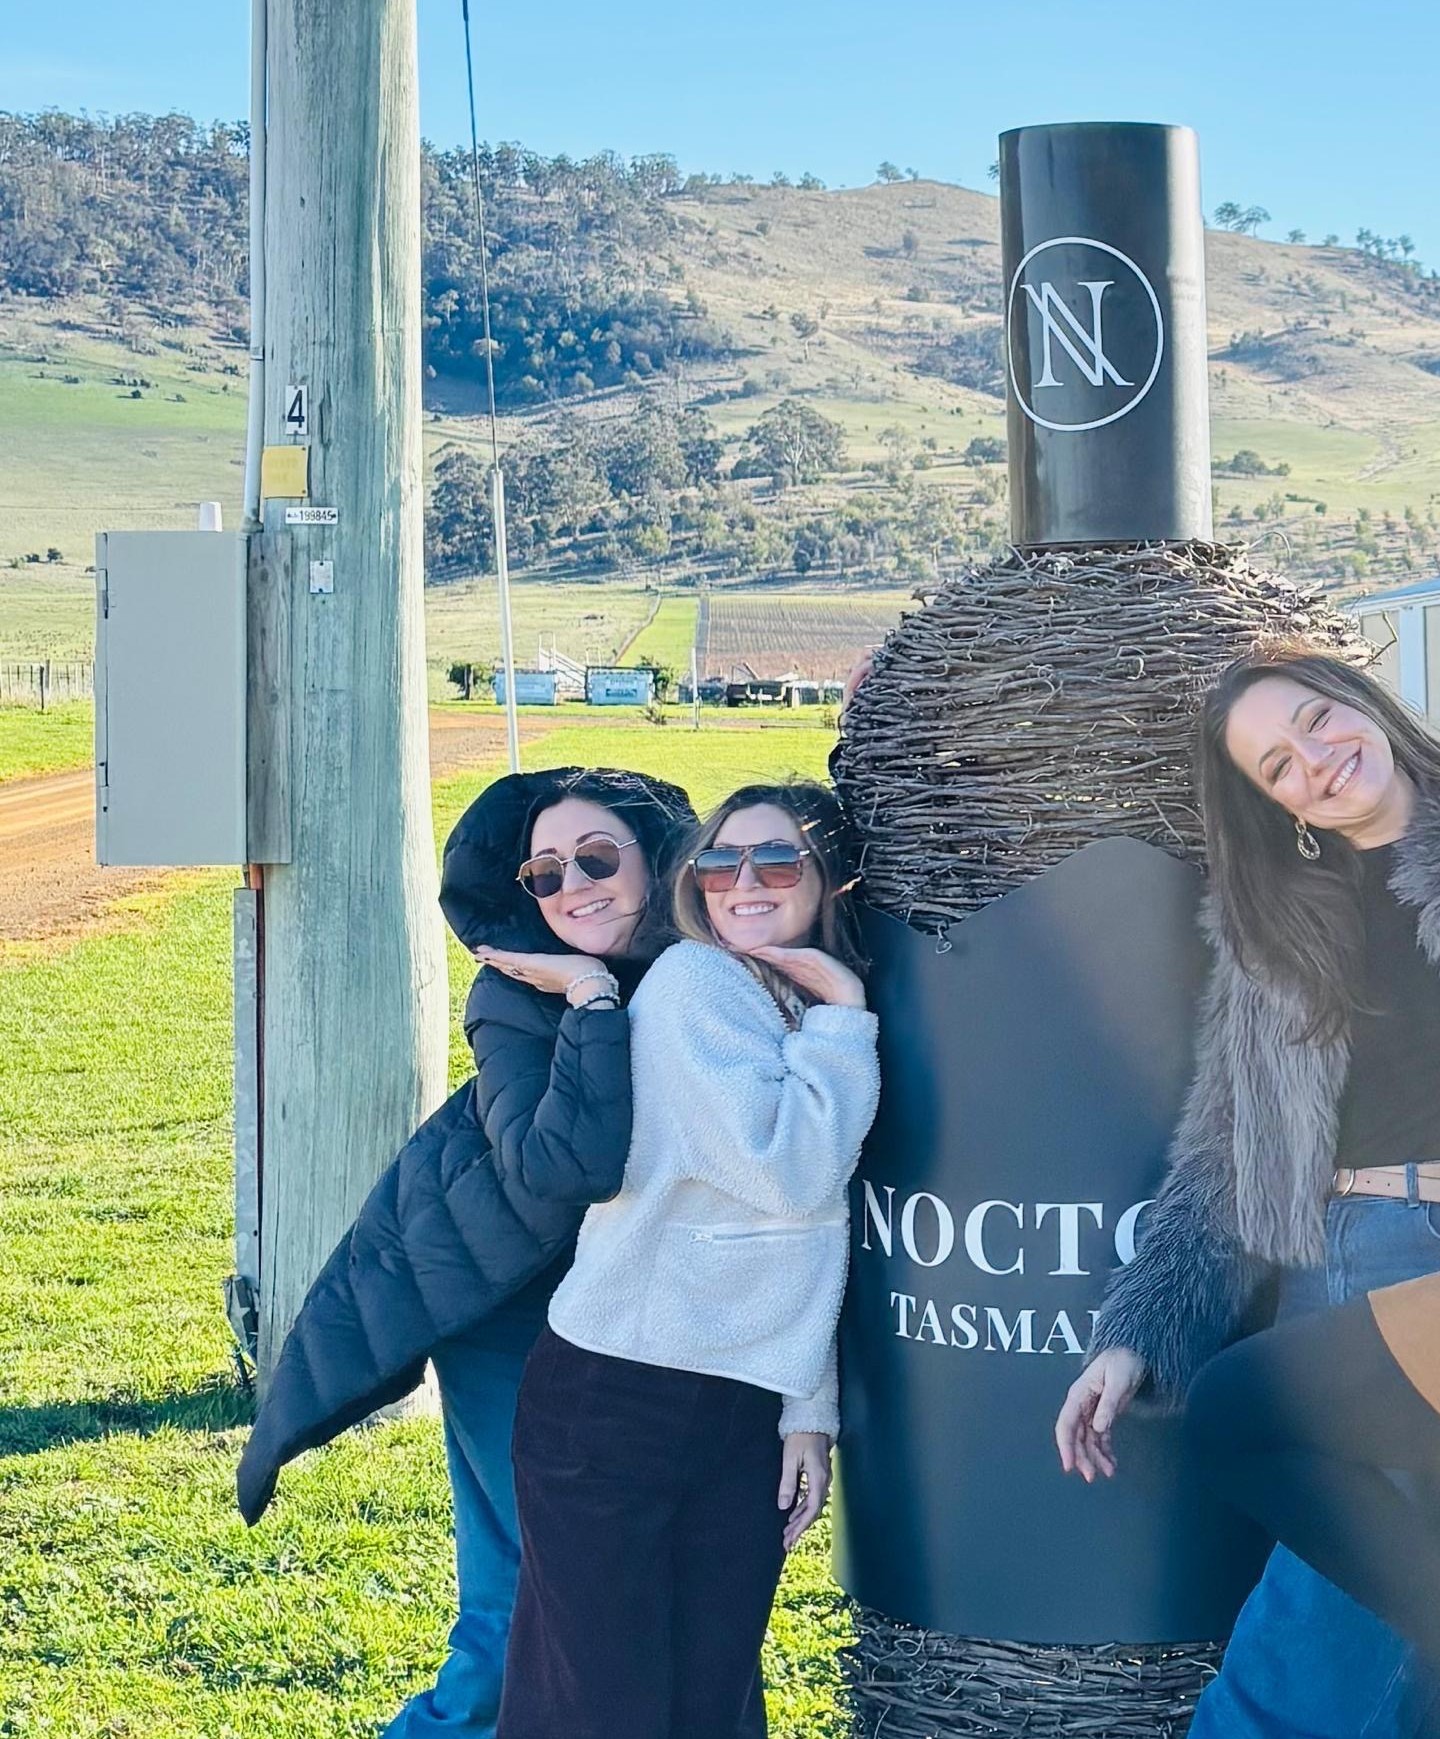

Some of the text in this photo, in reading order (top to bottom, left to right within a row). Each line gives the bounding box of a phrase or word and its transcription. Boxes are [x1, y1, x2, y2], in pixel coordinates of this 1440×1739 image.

[287, 389, 305, 428] 4
[861, 1179, 1156, 1275] NOCT
[890, 1291, 1101, 1354] TASMA
